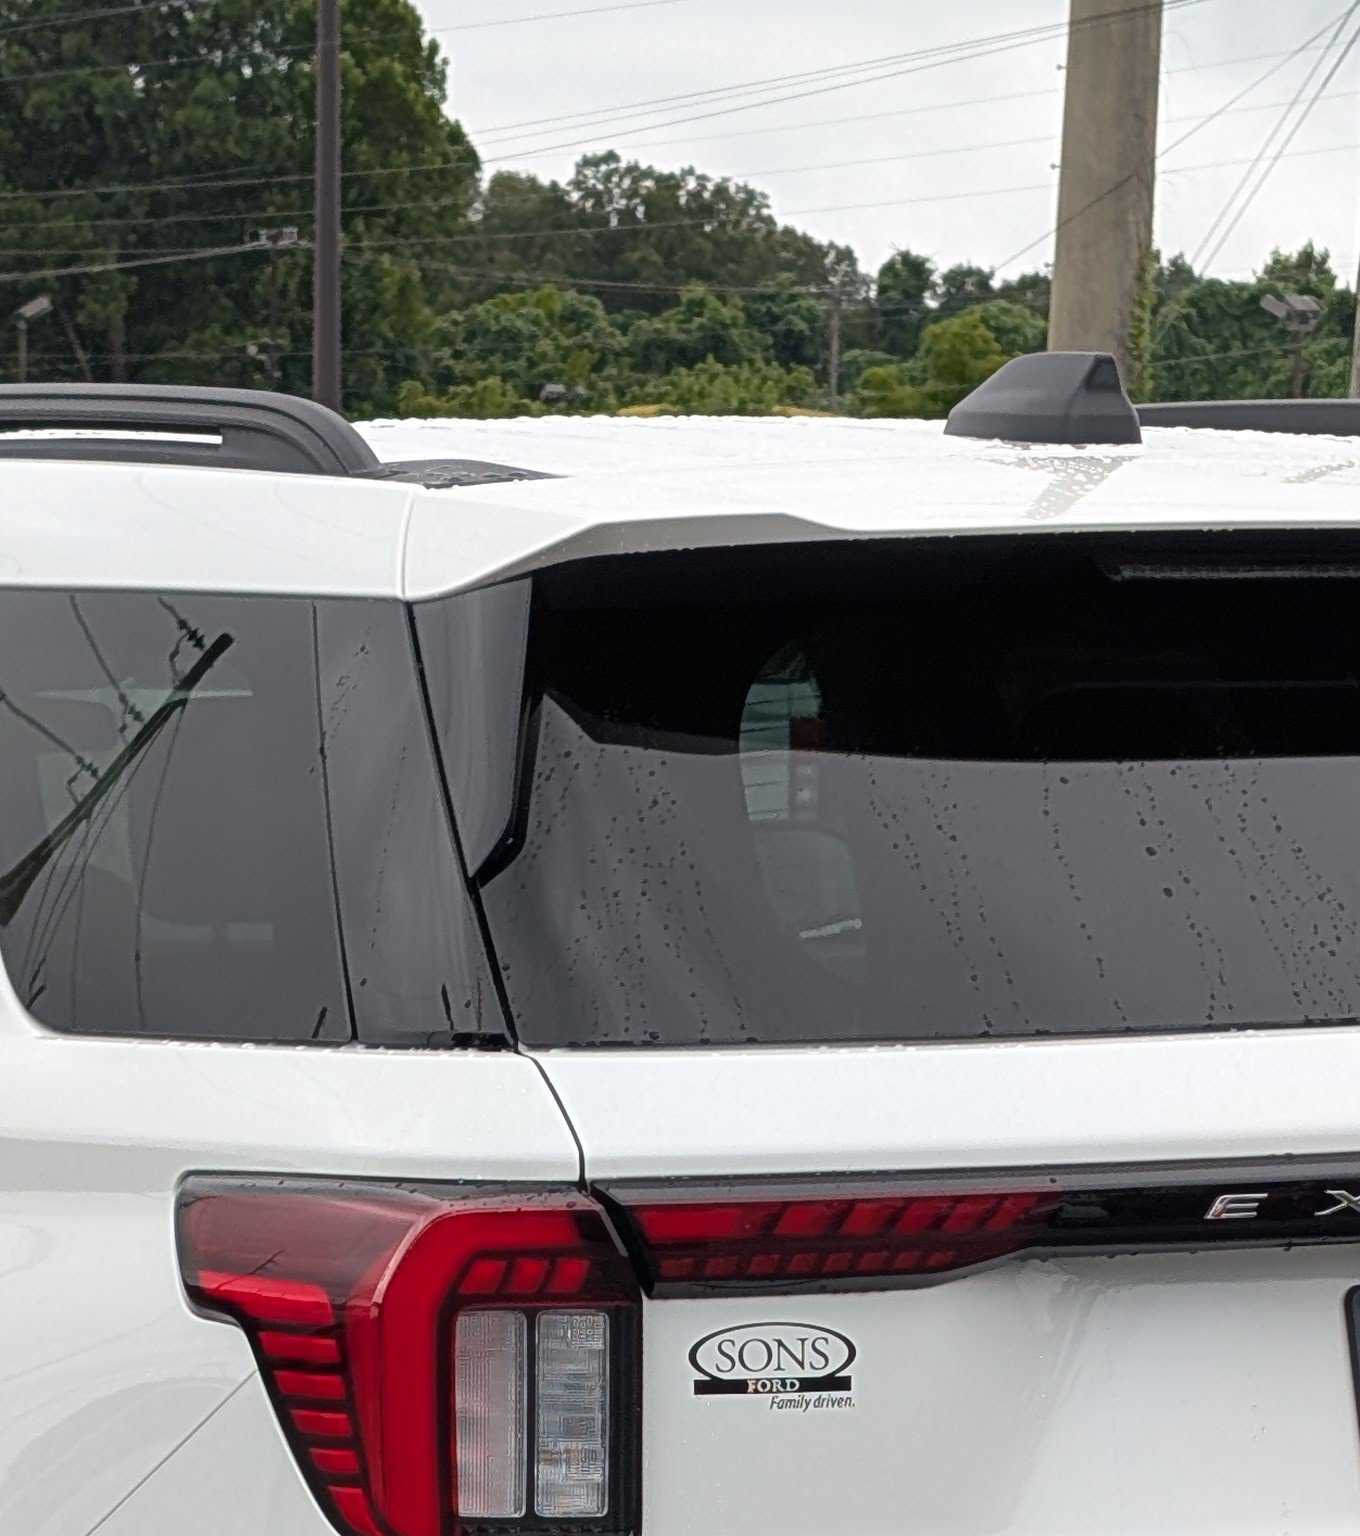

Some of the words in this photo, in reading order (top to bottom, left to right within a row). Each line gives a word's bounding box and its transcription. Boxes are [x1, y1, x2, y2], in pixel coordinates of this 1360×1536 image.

[715, 1337, 830, 1373] SONS
[746, 1379, 800, 1393] FORD
[769, 1396, 811, 1412] Family
[813, 1394, 856, 1409] driven.
